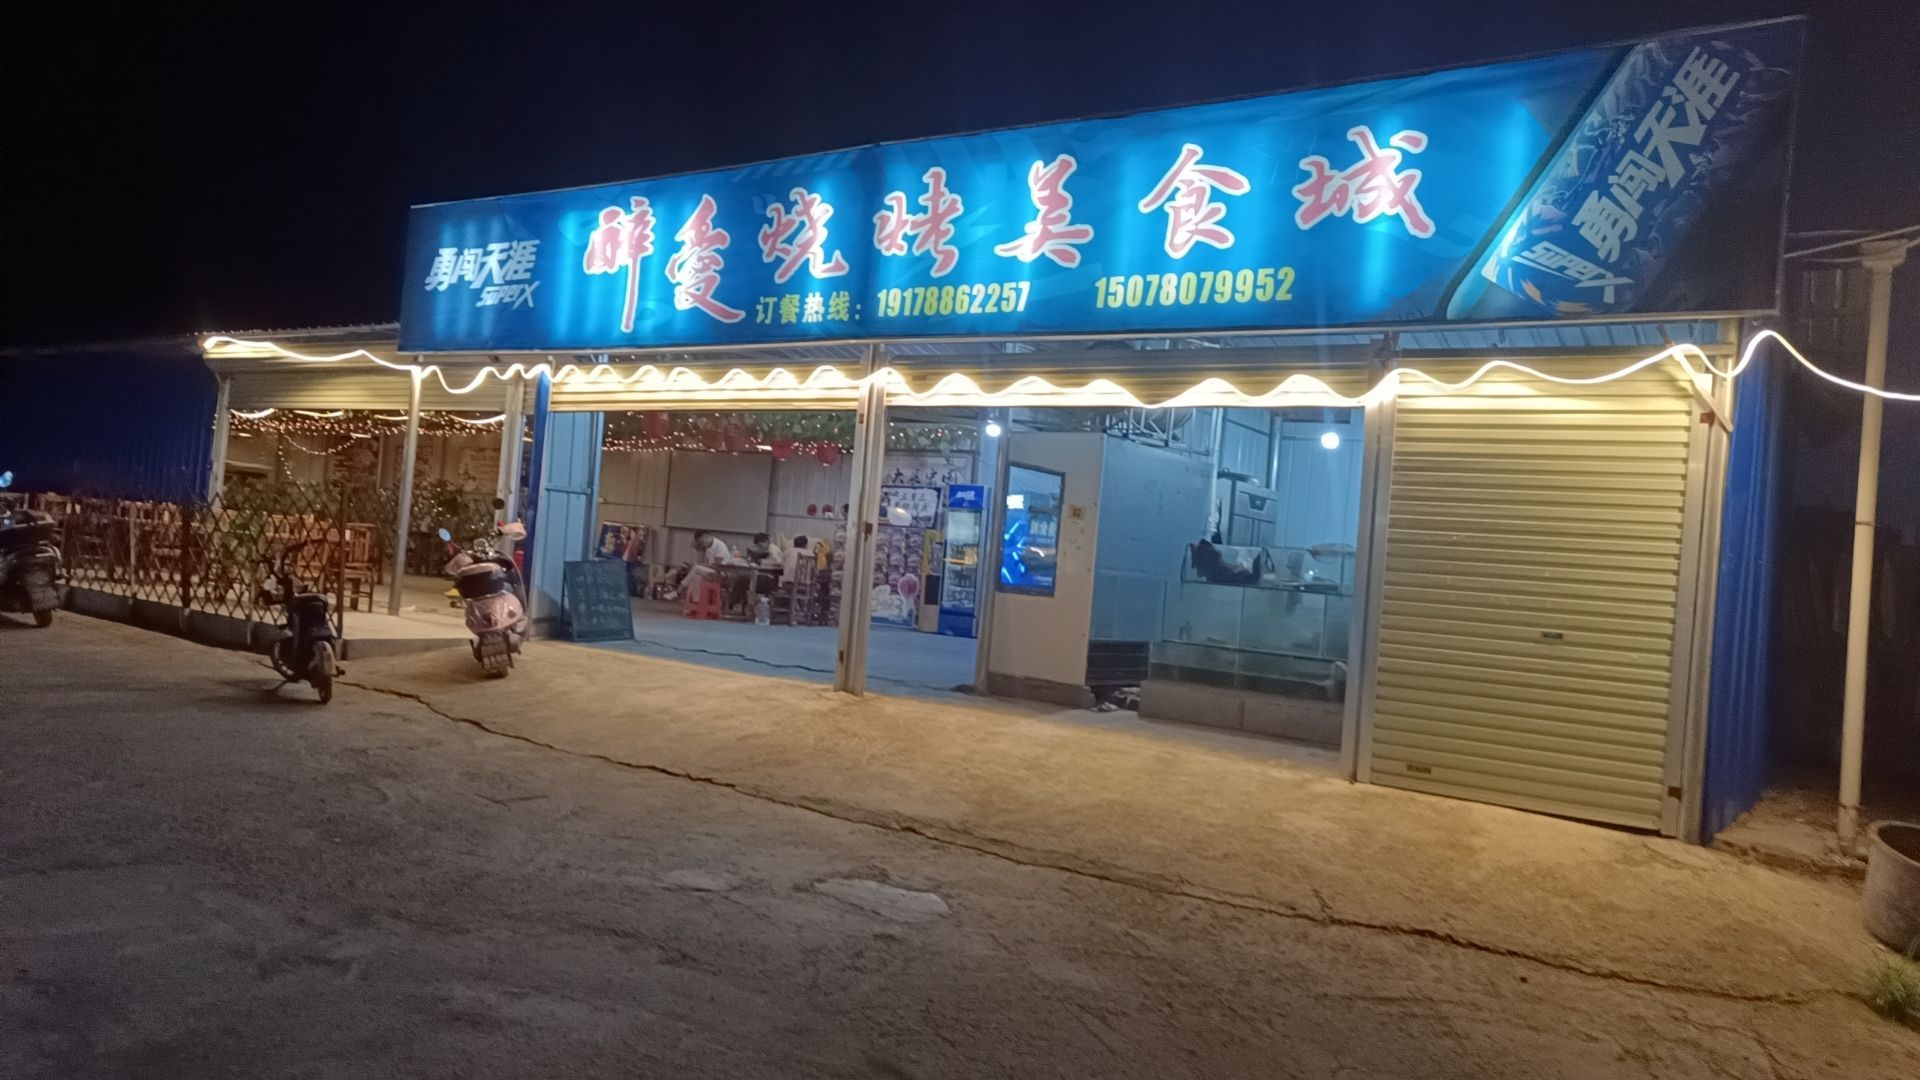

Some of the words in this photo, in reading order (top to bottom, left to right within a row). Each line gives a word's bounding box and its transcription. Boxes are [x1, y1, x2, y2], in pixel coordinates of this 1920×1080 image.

[1571, 46, 1740, 263] 勇闯天涯
[424, 239, 540, 291] 勇闯天涯
[877, 280, 1031, 318] 19178862257
[1095, 266, 1296, 309] 15078079952
